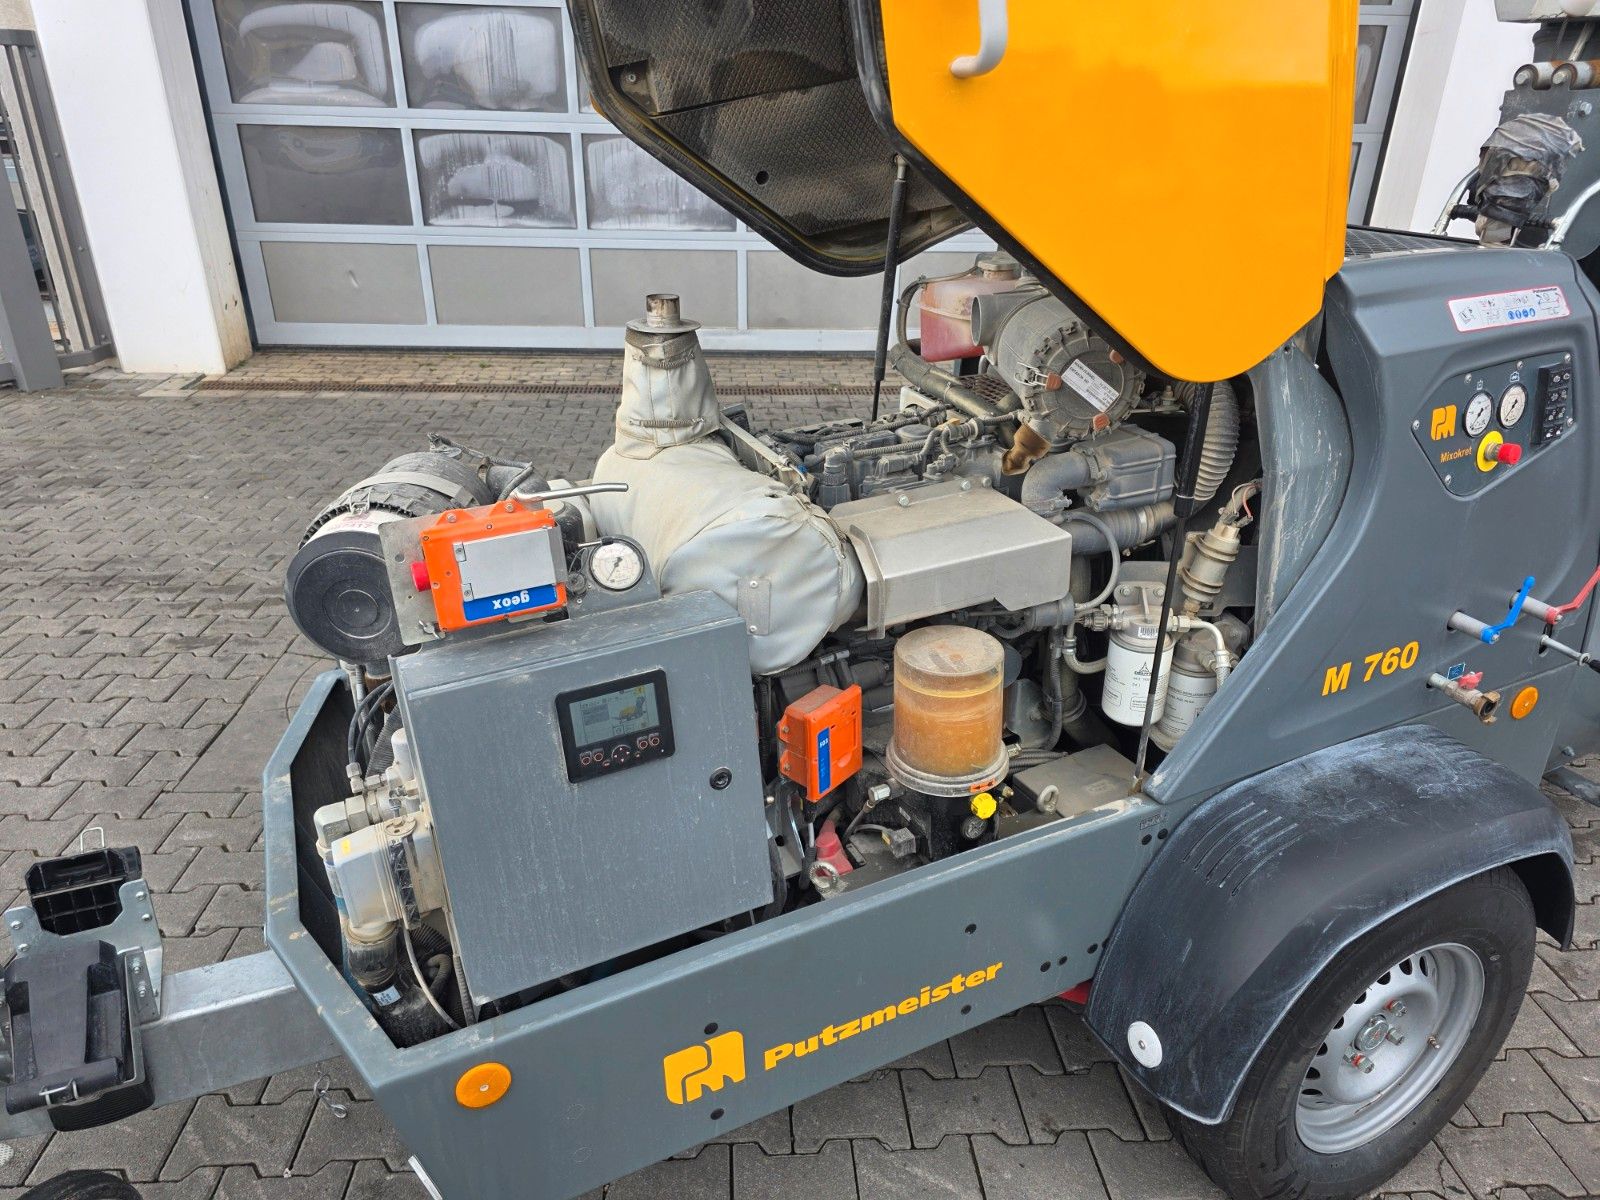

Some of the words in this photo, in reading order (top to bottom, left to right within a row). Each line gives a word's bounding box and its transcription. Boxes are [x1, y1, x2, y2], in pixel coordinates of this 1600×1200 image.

[1440, 447, 1472, 463] Mixokret
[492, 590, 530, 610] geox
[1321, 662, 1352, 696] M
[1363, 641, 1419, 683] 760
[763, 961, 1004, 1072] Putzmeister
